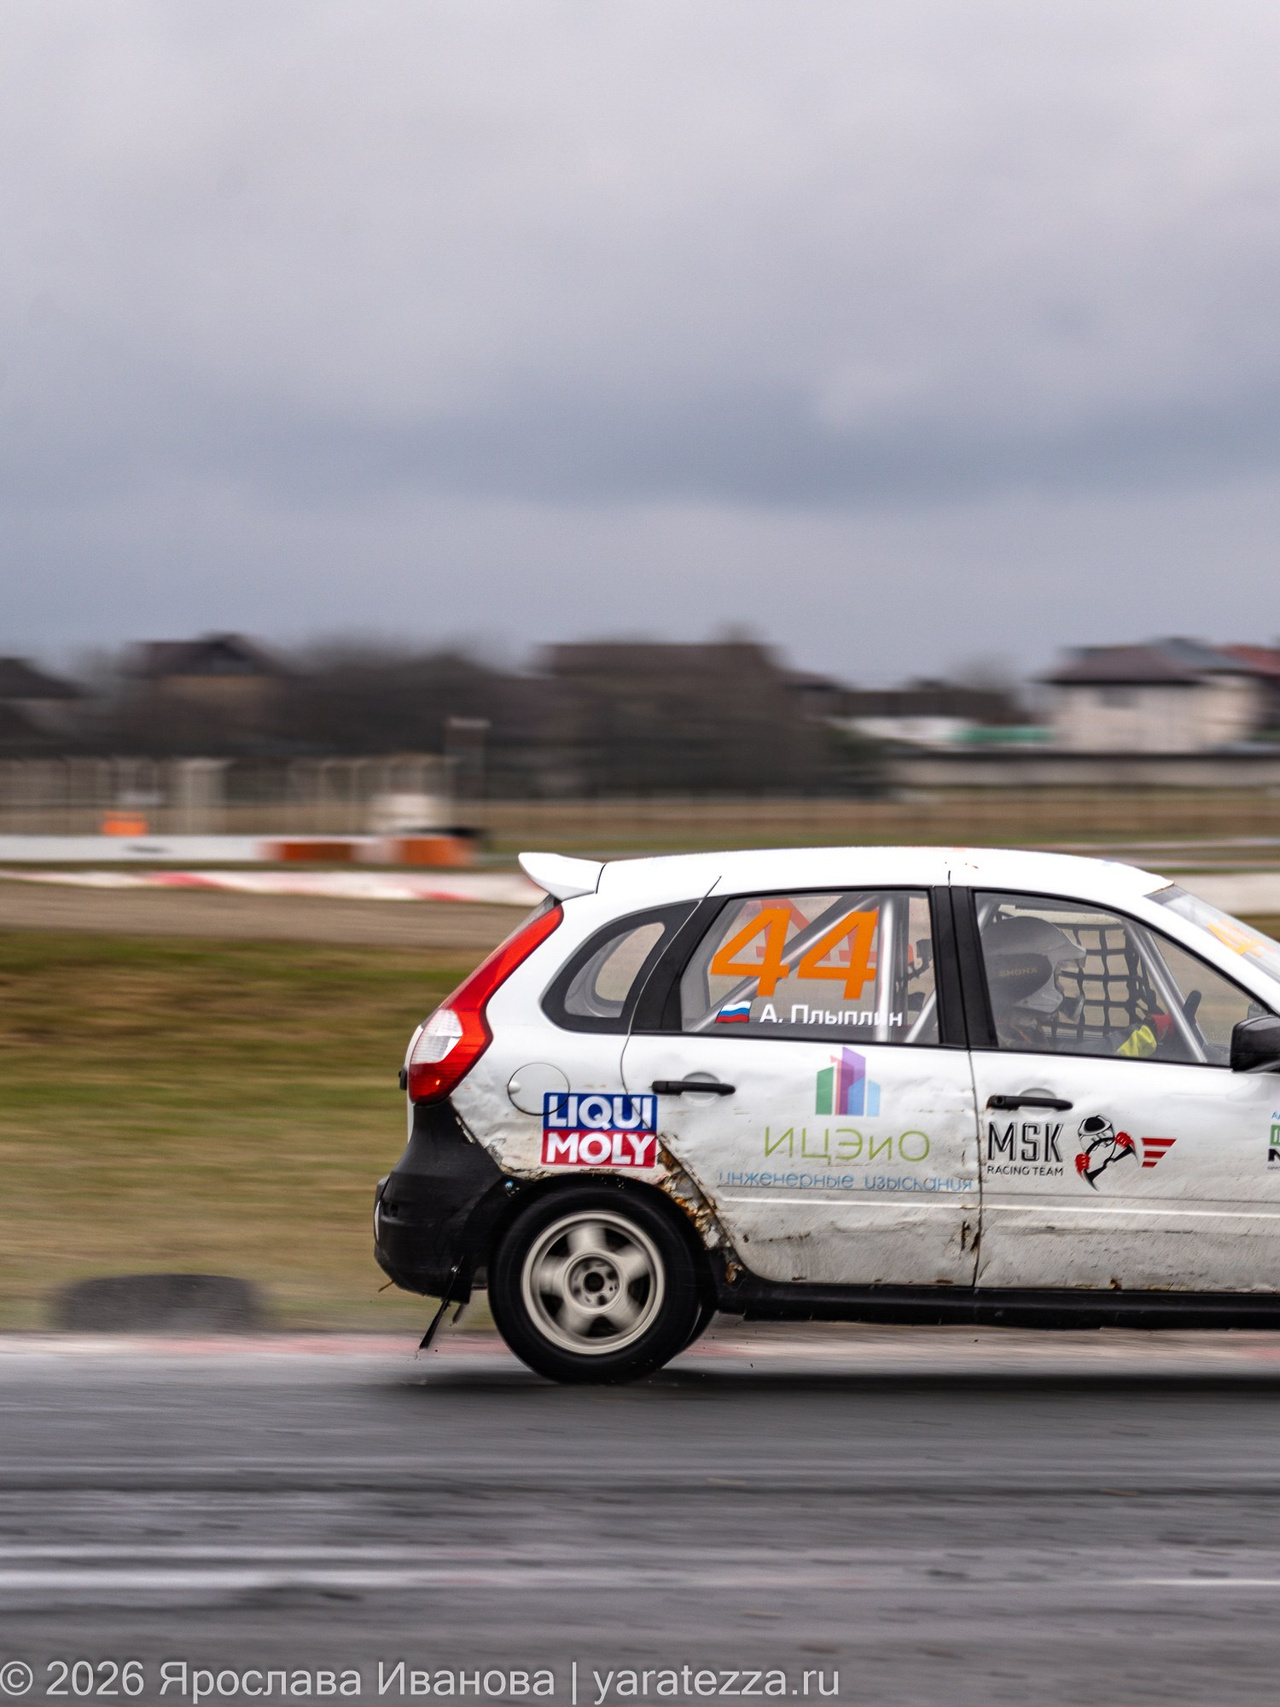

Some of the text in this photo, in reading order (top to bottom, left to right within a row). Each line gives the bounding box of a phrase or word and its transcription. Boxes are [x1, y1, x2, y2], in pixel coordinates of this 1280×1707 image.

[710, 908, 879, 1000] 44
[759, 1003, 783, 1024] А.
[548, 1095, 653, 1130] LIQUI
[546, 1132, 656, 1165] MOLY
[987, 1121, 1064, 1163] MSK
[719, 1171, 973, 1192] инженерные изыскания
[986, 1165, 1064, 1176] RACING TEAM
